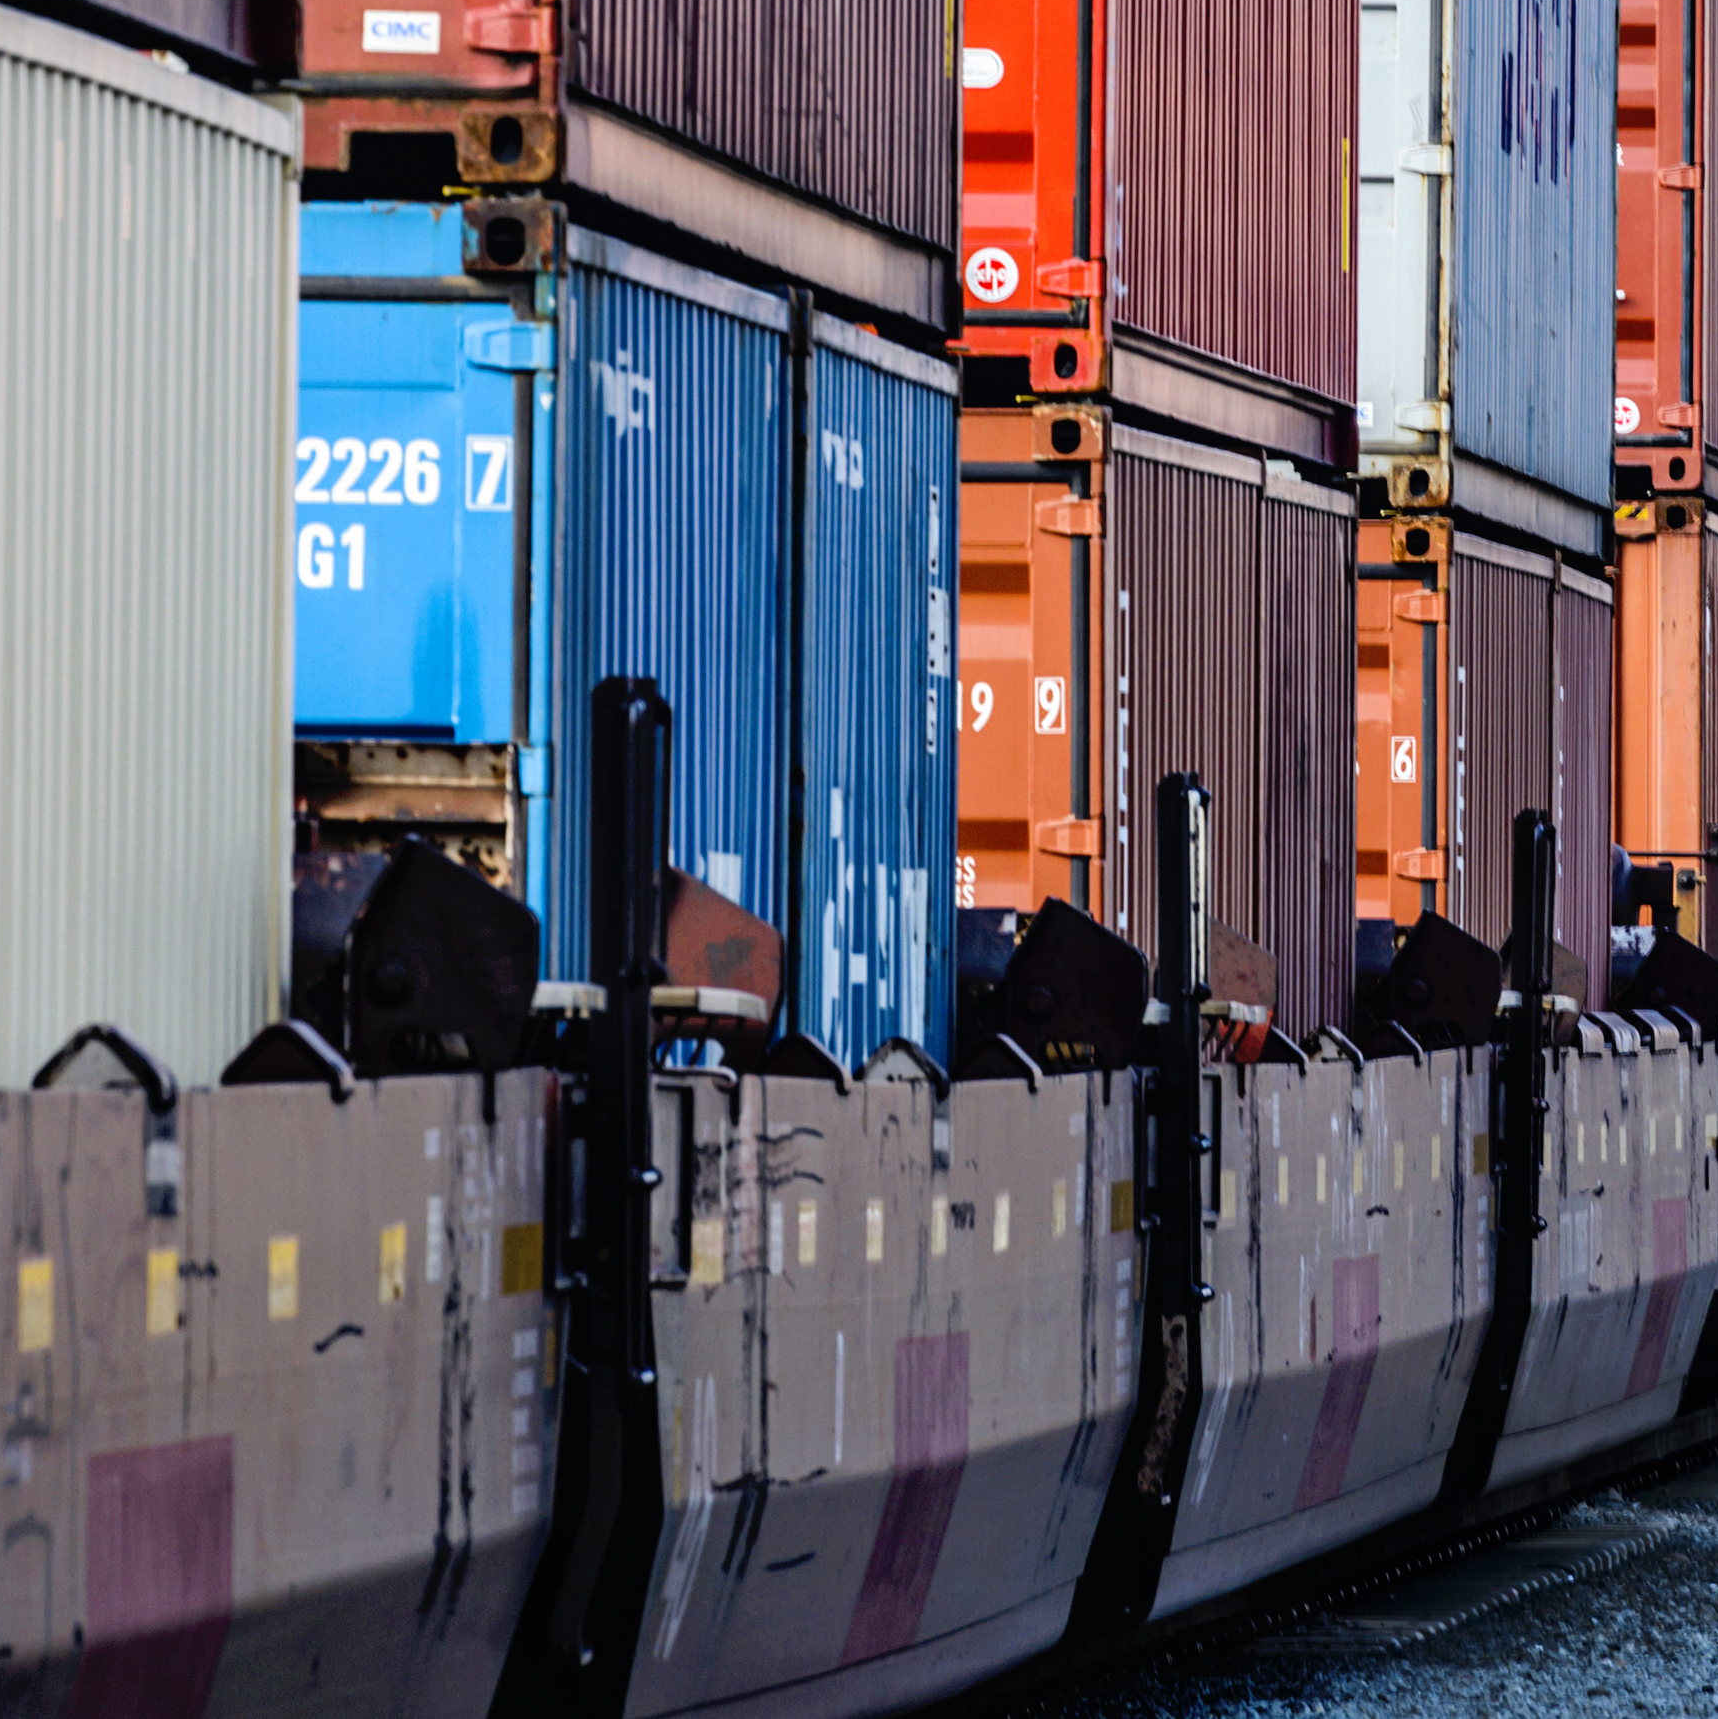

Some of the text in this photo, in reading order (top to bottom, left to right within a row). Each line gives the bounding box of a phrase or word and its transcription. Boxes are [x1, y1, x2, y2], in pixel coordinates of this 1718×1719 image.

[370, 20, 431, 41] CIMC
[294, 437, 508, 507] 2226 7
[1038, 679, 1062, 732] 9
[1394, 739, 1413, 781] 6
